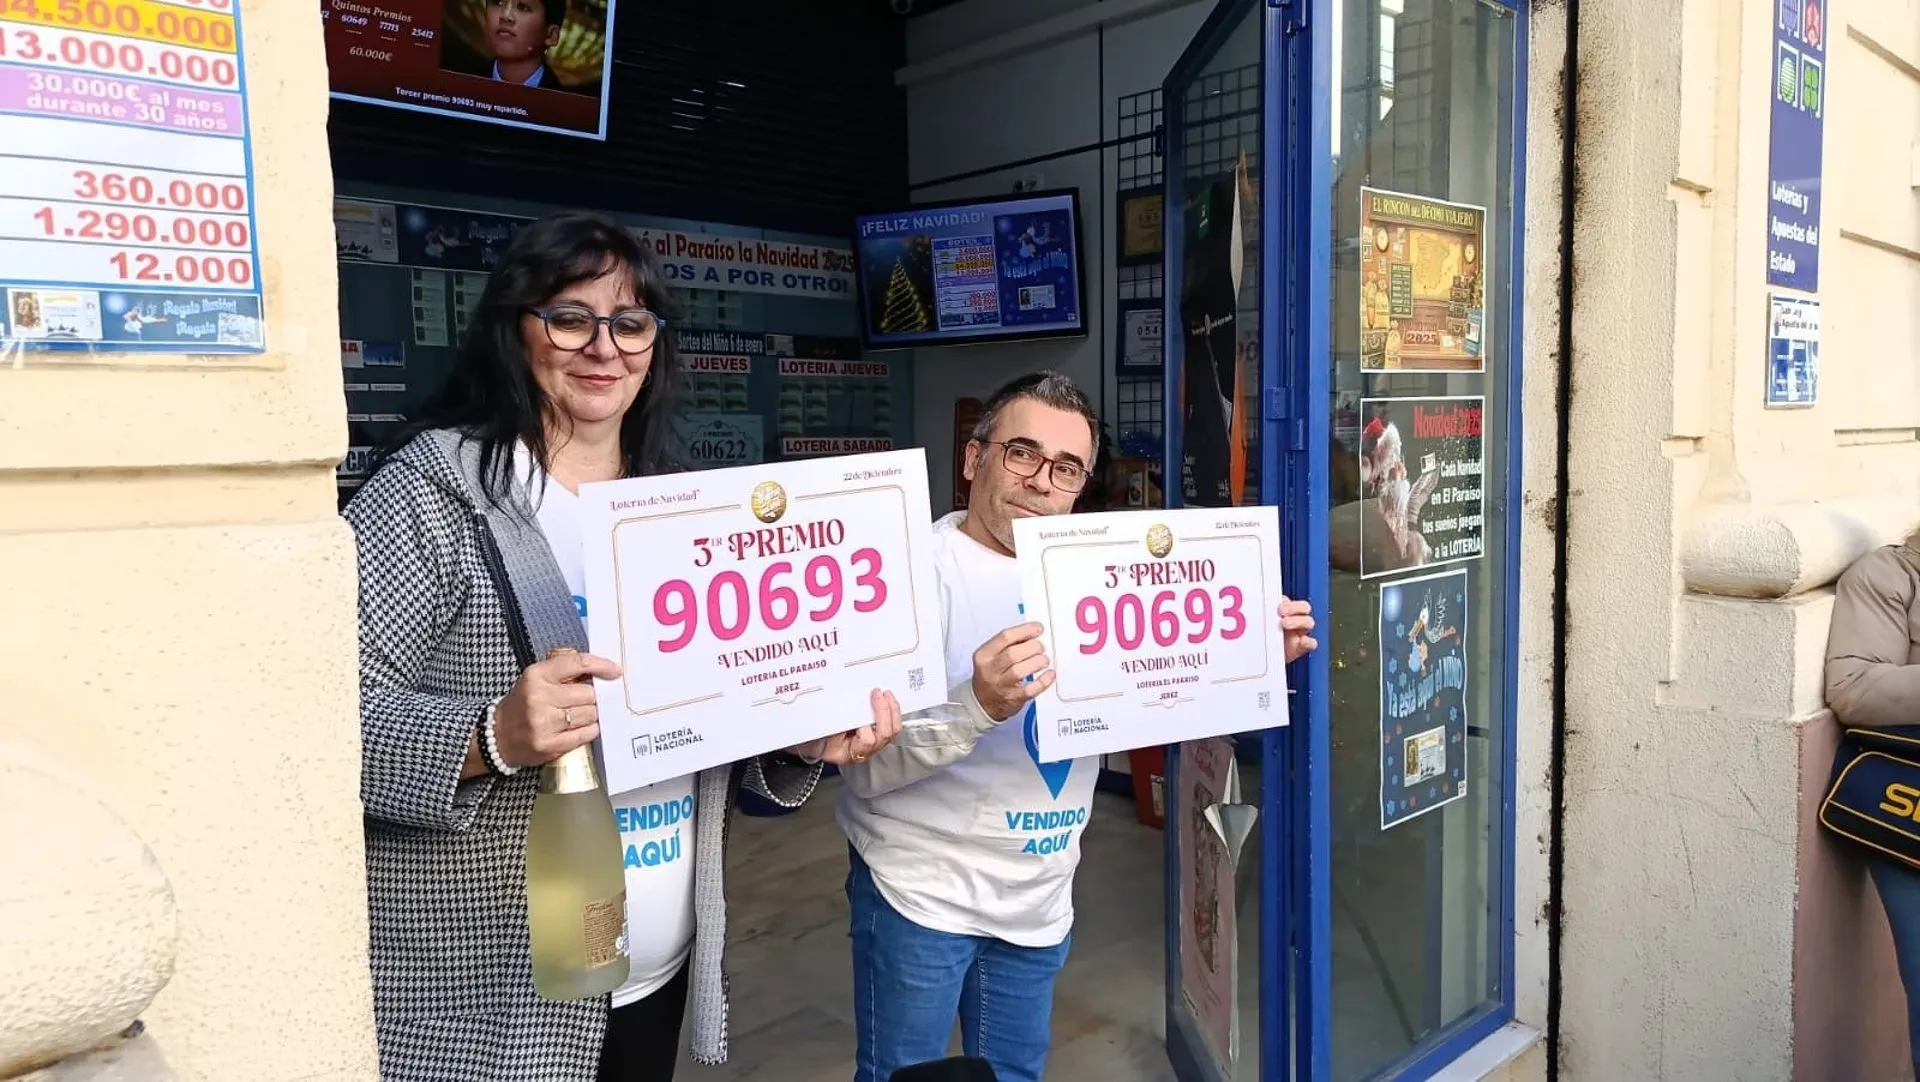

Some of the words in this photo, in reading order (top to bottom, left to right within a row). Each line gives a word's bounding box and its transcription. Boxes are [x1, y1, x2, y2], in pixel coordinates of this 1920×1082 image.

[0, 0, 233, 47] 4.500.000
[332, 0, 371, 14] Quintos
[372, 6, 413, 23] Premios
[341, 14, 368, 26] 60649
[349, 46, 393, 62] 60.000€
[27, 71, 142, 102] 30.000€
[148, 90, 170, 107] al
[176, 96, 225, 114] mes
[395, 87, 421, 99] Tercer
[423, 92, 451, 105] premio
[476, 101, 493, 112] muy
[26, 92, 128, 119] durante
[134, 102, 166, 123] 30
[174, 110, 228, 130] años
[72, 170, 245, 210] 360.000
[1373, 197, 1382, 212] EL
[1445, 209, 1474, 226] VIAJERO
[1802, 194, 1809, 215] y
[34, 207, 248, 247] 1.290.000
[862, 218, 909, 238] ¡FELIZ
[912, 211, 985, 231] NAVIDAD!
[1771, 215, 1805, 242] Apuestas
[1806, 224, 1818, 246] del
[656, 233, 670, 255] al
[675, 234, 735, 263] Paraíso
[739, 241, 753, 263] la
[757, 242, 818, 270] Navidad
[1770, 250, 1796, 274] Estado
[110, 252, 250, 284] 12.000
[704, 266, 720, 283] A
[728, 269, 775, 287] POR
[783, 273, 848, 293] OTRO!
[678, 330, 701, 352] Sorteo
[702, 331, 712, 352] del
[736, 333, 746, 354] de
[745, 338, 764, 354] enero
[690, 356, 748, 371] JUEVES
[781, 361, 837, 375] LOTERIA
[841, 362, 888, 376] JUEVES
[690, 439, 747, 460] 60622
[786, 439, 839, 453] LOTERIA
[844, 437, 891, 452] SABADO
[843, 472, 853, 481] 22
[853, 470, 862, 480] de
[1440, 460, 1456, 478] Cada
[1457, 457, 1482, 476] Navidad
[647, 495, 659, 506] de
[660, 488, 701, 505] Navidad
[1431, 492, 1441, 505] en
[1443, 487, 1451, 504] El
[1068, 528, 1079, 537] de
[1423, 519, 1434, 534] tus
[1458, 513, 1482, 533] juegan
[728, 518, 845, 561] PREMIO
[1434, 547, 1440, 559] a
[1441, 541, 1448, 557] la
[1129, 558, 1215, 587] PREMIO
[653, 547, 888, 654] 90693
[1075, 585, 1247, 655] 90693
[717, 640, 794, 670] VENDIDO
[798, 626, 840, 653] AQUÍ
[779, 668, 789, 677] EL
[791, 659, 827, 674] PARAISO
[1121, 655, 1176, 675] VENDIDO
[1178, 649, 1209, 670] AQUÍ
[775, 682, 800, 695] JEREZ
[1163, 678, 1171, 686] EL
[1159, 691, 1179, 700] JEREZ
[1387, 681, 1398, 719] Ya
[1074, 723, 1109, 734] NACIONAL
[655, 734, 704, 753] NACIONAL
[614, 795, 694, 833] ENDIDO
[1879, 783, 1920, 823] S
[1005, 806, 1085, 831] VENDIDO
[623, 827, 681, 870] AQUÍ
[1021, 829, 1072, 857] AQUÍ
